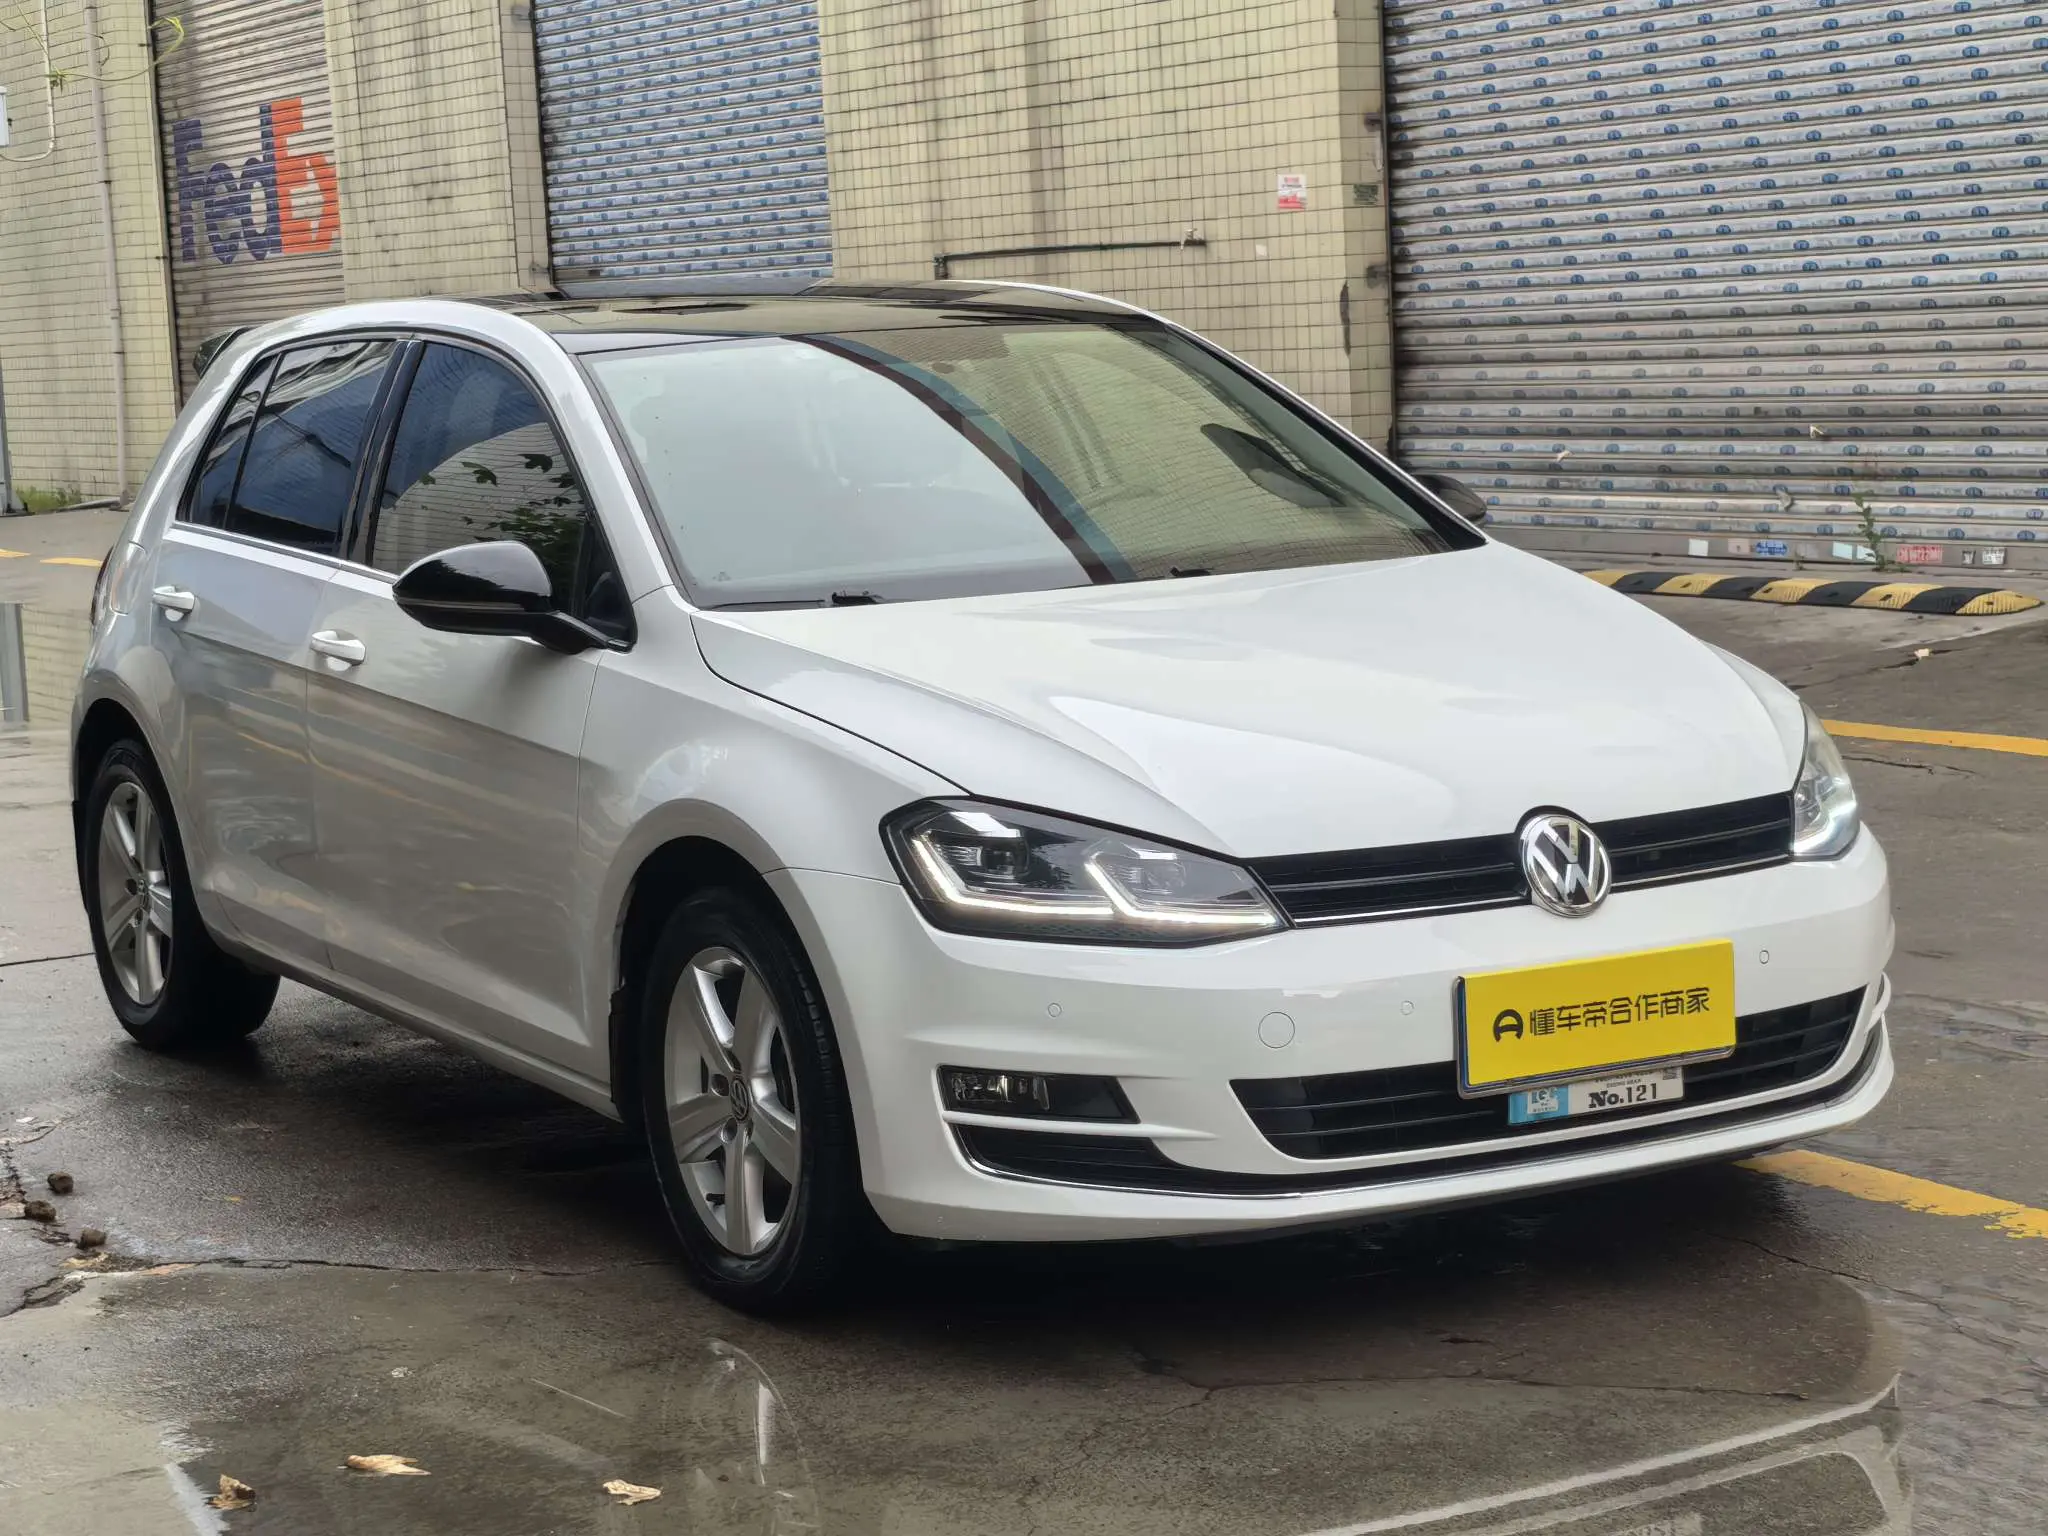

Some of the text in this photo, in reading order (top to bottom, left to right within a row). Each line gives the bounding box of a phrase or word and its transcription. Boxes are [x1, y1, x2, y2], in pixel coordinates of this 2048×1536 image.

[1529, 987, 1710, 1037] 懂车帝合作商家
[1588, 1083, 1657, 1109] No.121
